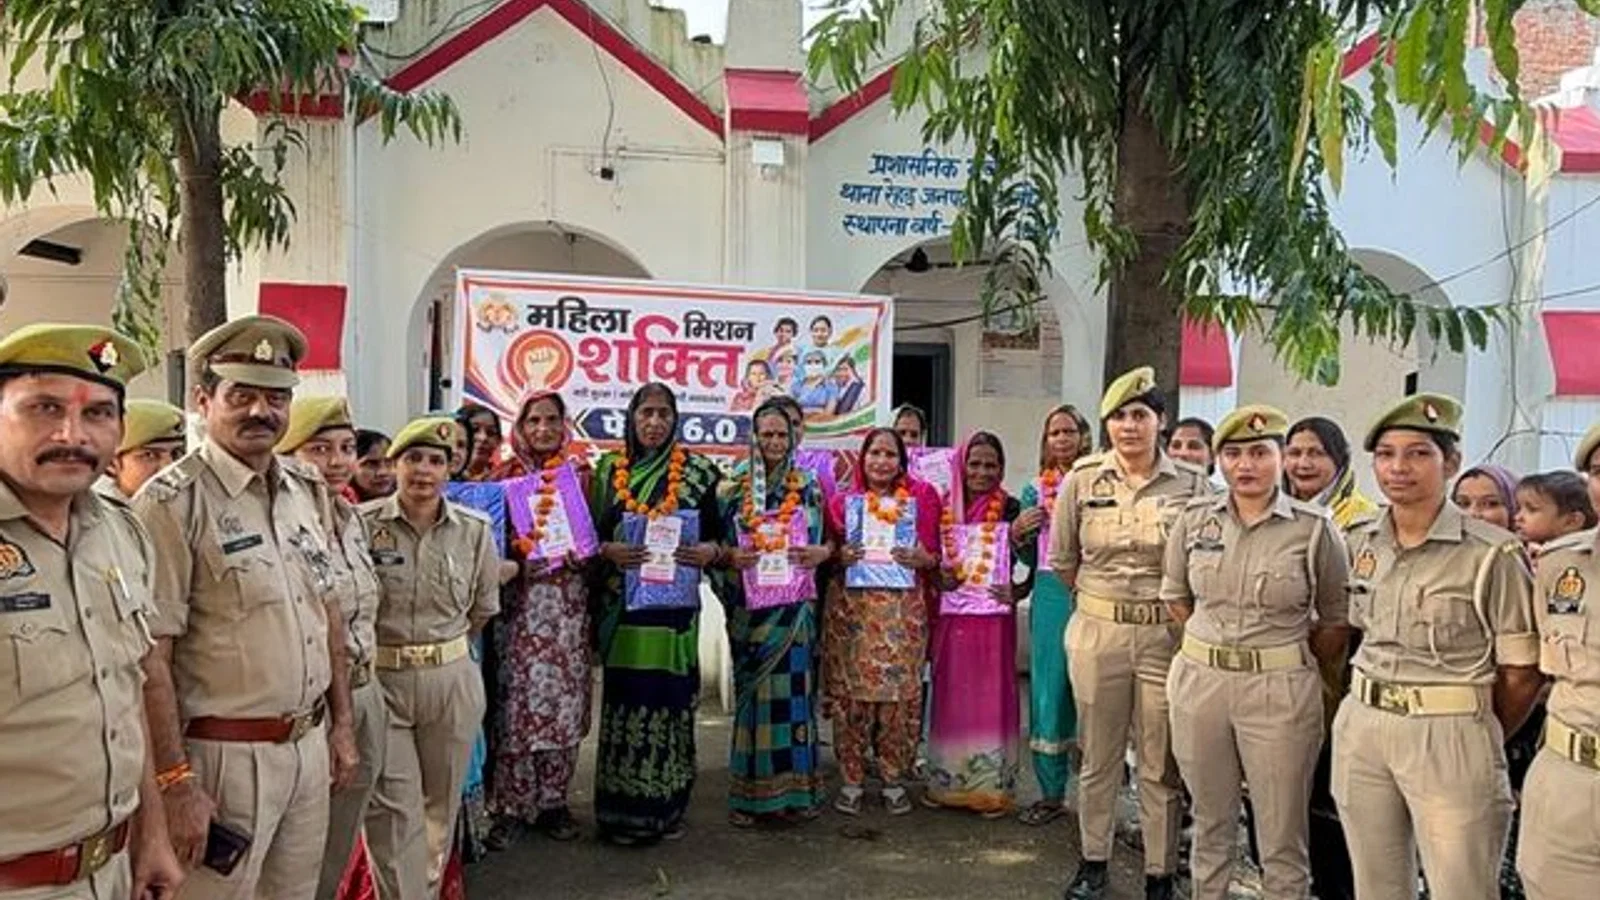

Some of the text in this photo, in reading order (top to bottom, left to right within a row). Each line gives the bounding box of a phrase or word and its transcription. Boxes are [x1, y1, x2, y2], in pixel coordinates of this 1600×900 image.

[868, 148, 961, 178] प्रशासनिक
[840, 182, 882, 205] थाना
[842, 214, 906, 236] स्थापना
[527, 297, 756, 342] महिला मिशन
[577, 314, 745, 388] शक्ति
[682, 418, 737, 444] 6.0
